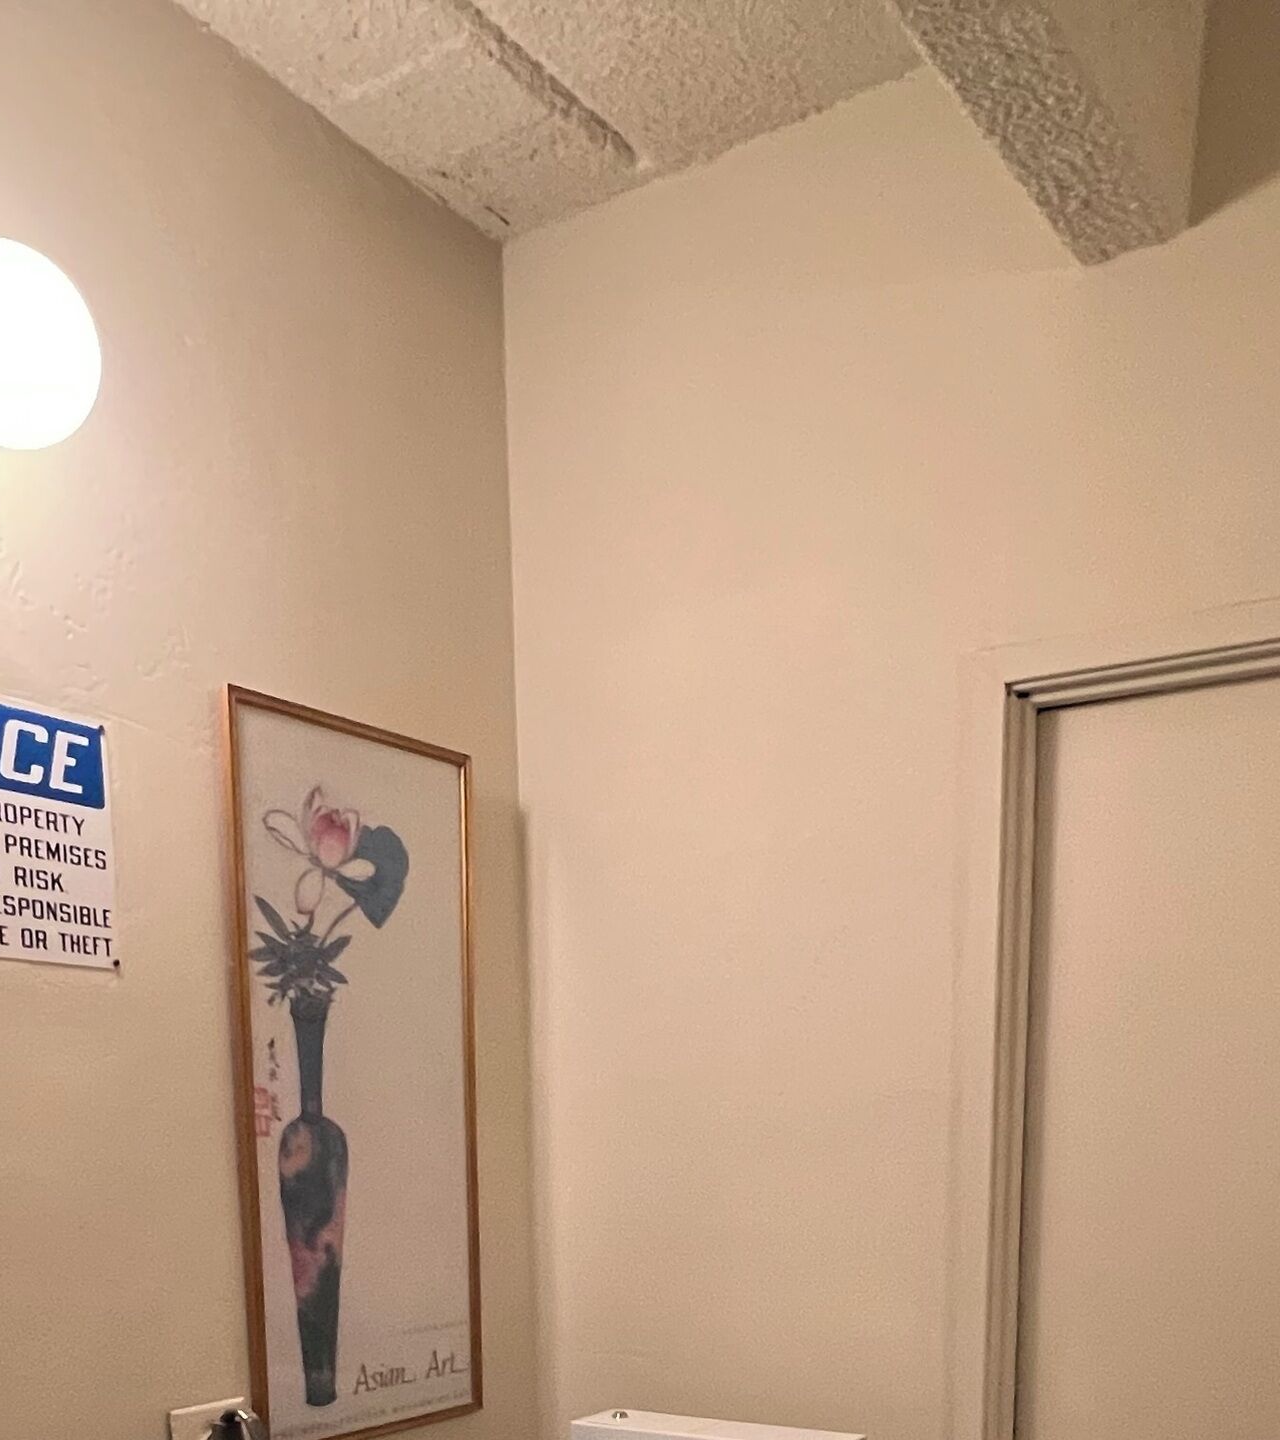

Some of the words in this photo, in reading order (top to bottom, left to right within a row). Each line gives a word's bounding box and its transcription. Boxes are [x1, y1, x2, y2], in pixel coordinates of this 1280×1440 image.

[4, 834, 107, 870] PREMISES
[13, 866, 65, 893] RISK
[20, 927, 48, 951] OR
[58, 931, 113, 958] THEFT
[353, 1363, 415, 1395] Asian
[425, 1350, 469, 1380] Art
